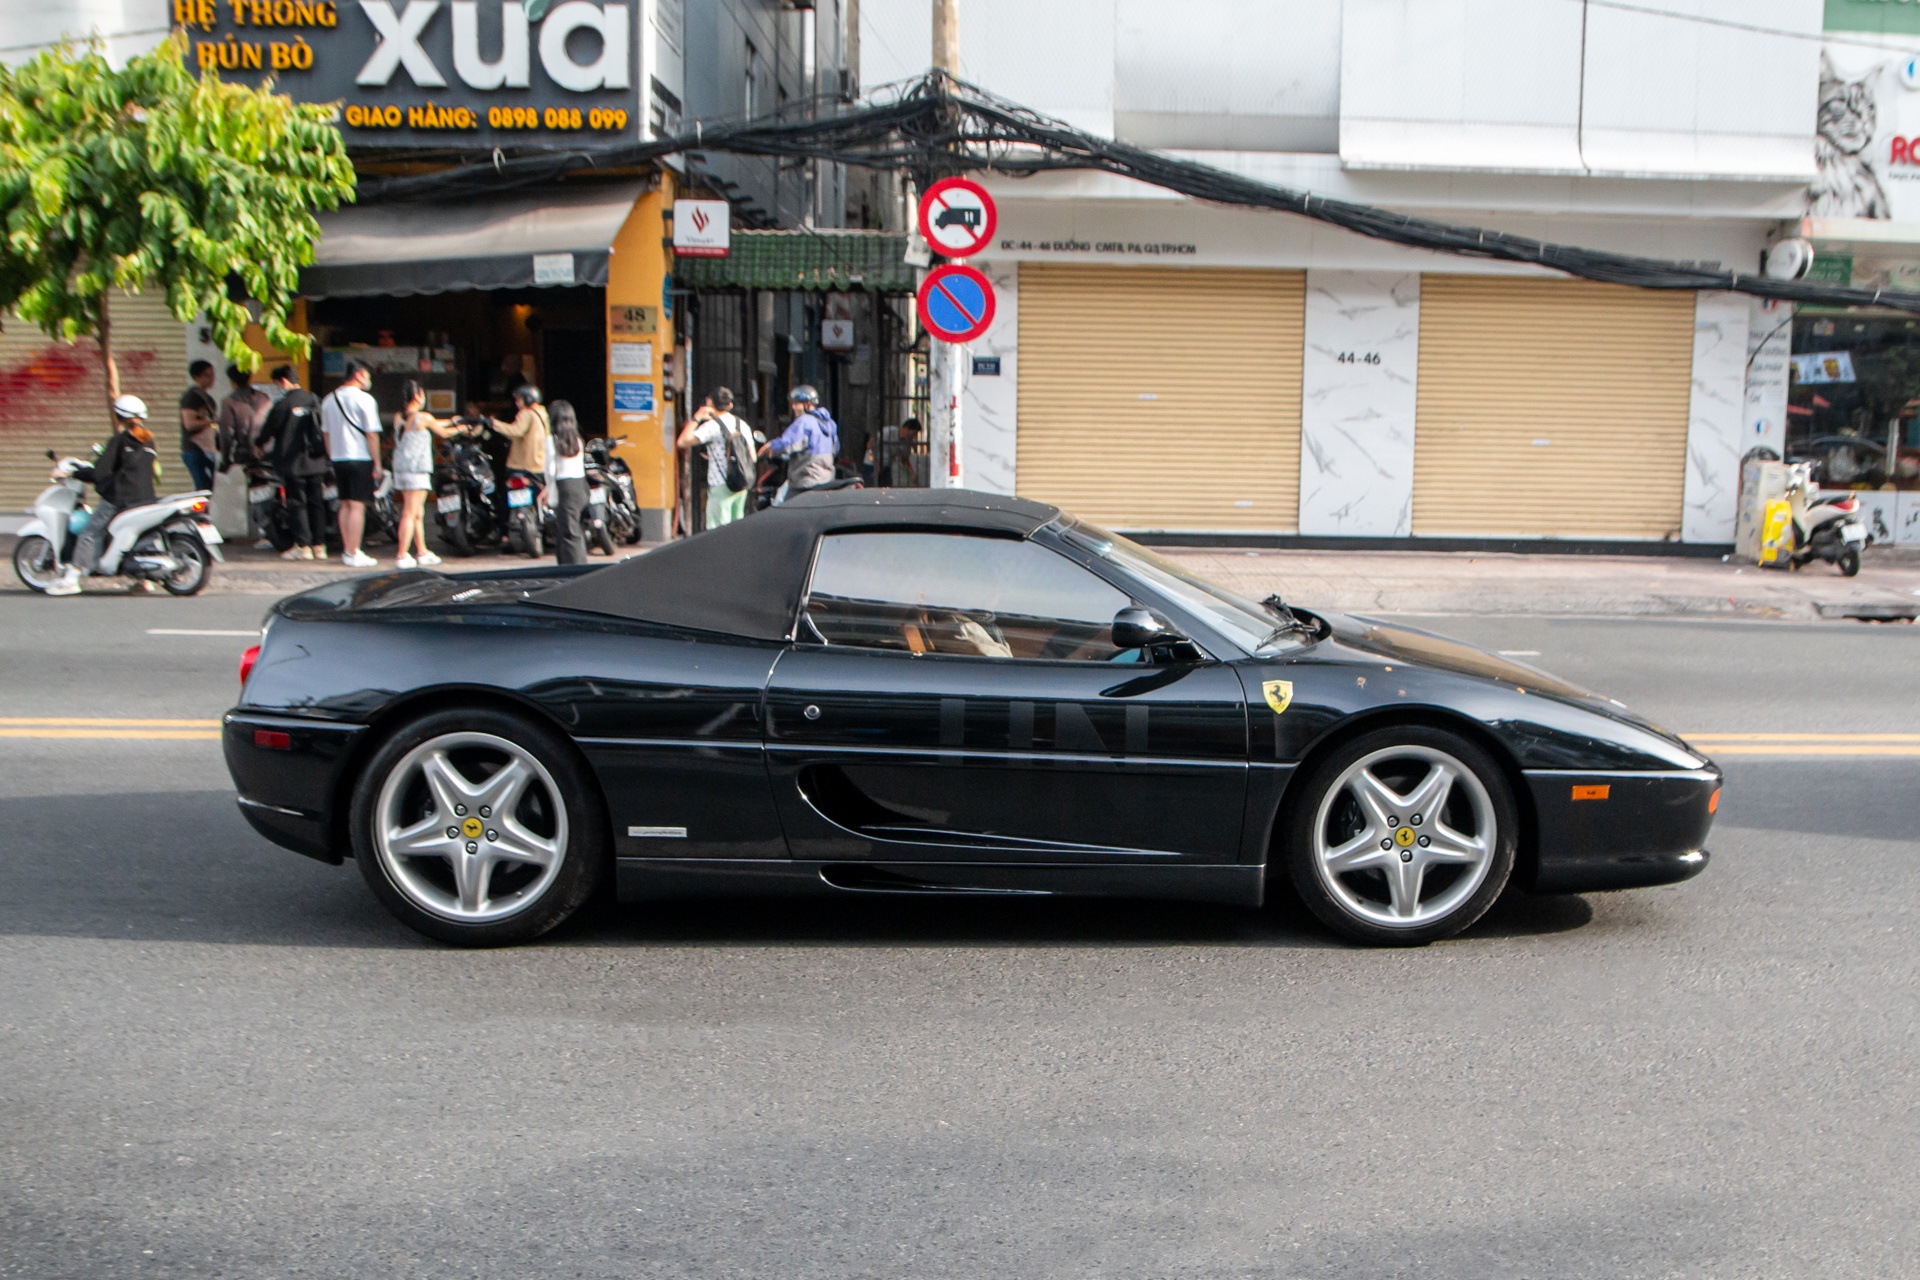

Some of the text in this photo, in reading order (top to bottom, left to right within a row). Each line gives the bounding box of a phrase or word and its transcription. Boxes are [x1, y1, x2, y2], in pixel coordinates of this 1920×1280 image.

[196, 33, 313, 69] BÚN BÒ
[345, 101, 628, 130] GIAO HÀNG: 0898 088 099
[624, 307, 646, 321] 48
